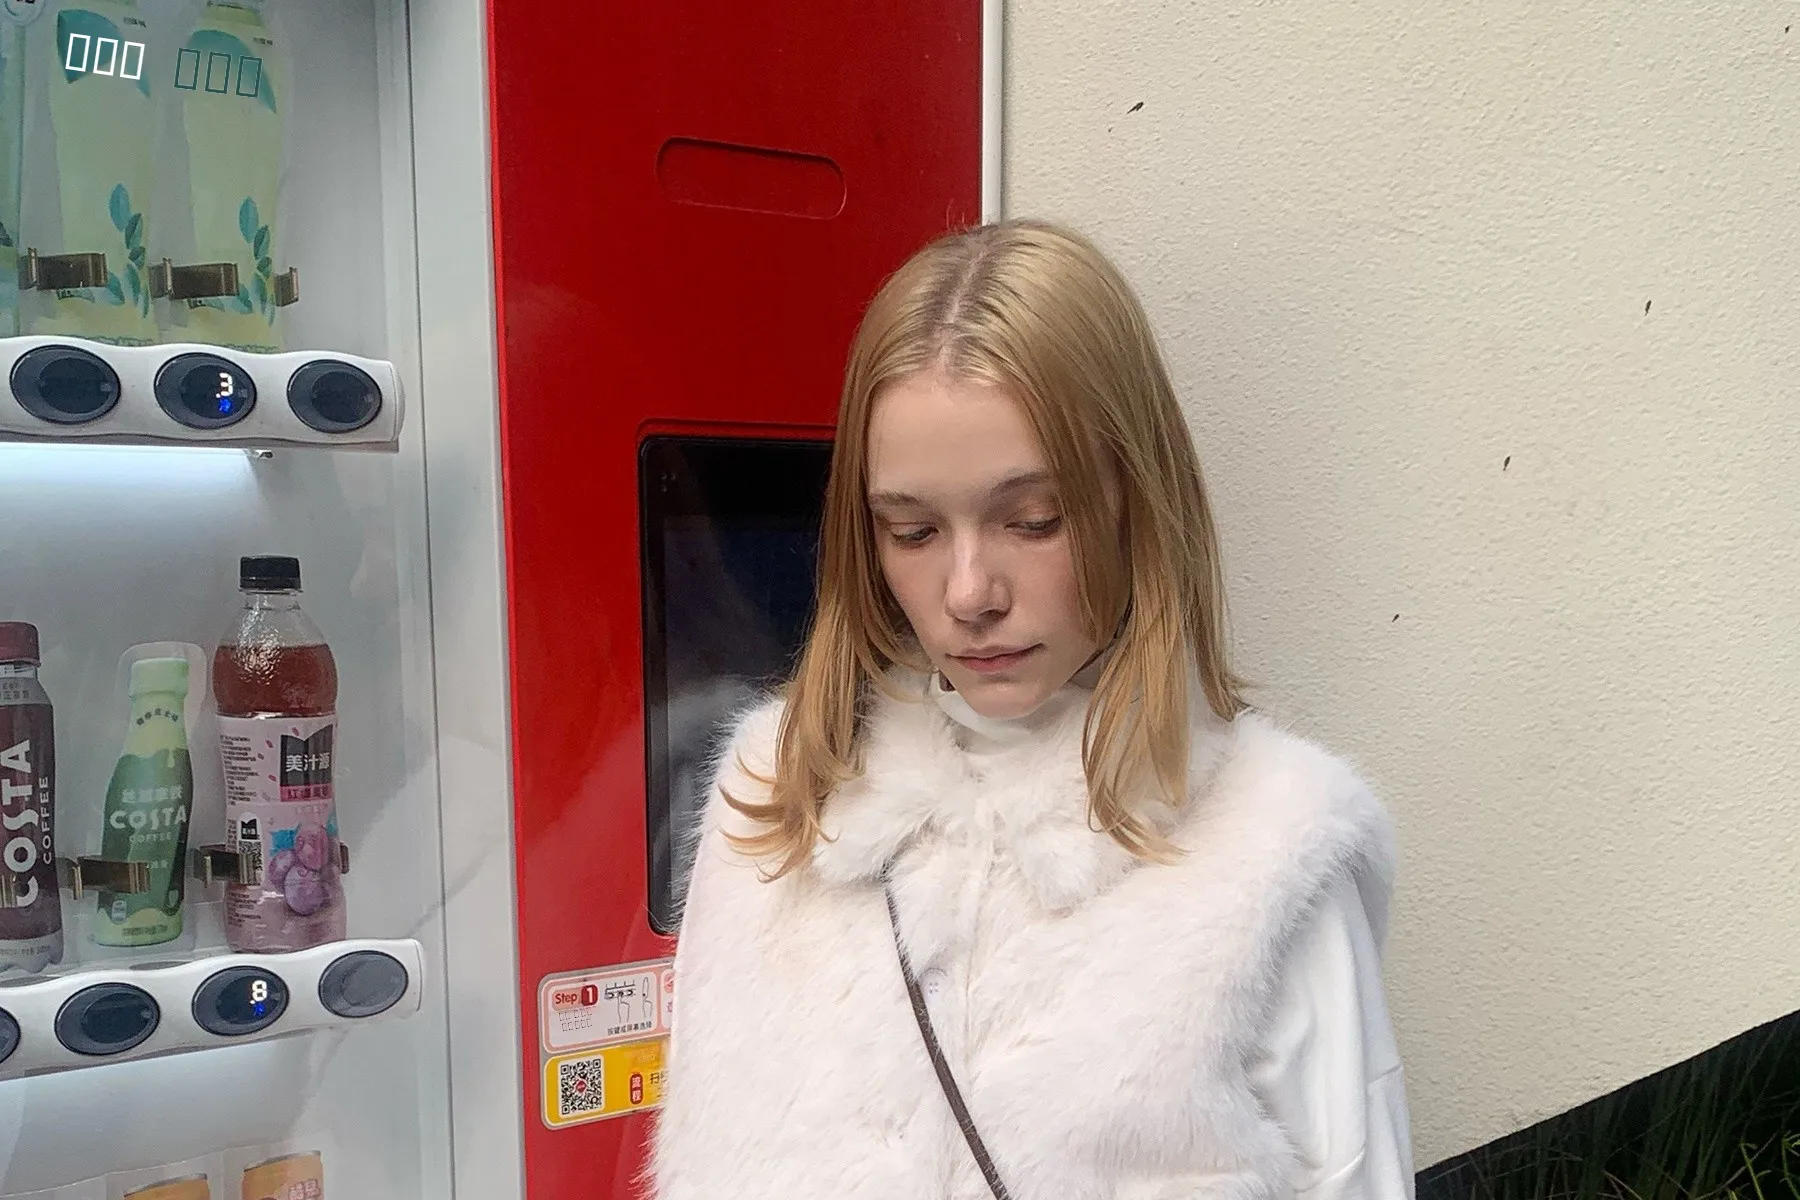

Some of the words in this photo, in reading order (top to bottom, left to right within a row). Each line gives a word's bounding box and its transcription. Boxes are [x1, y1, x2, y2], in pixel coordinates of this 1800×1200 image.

[285, 752, 330, 772] 美汁源
[0, 739, 39, 908] COSTA
[38, 776, 52, 866] COFFEE
[109, 804, 187, 831] COSTA
[555, 992, 577, 1005] Step
[587, 987, 594, 1004] 1
